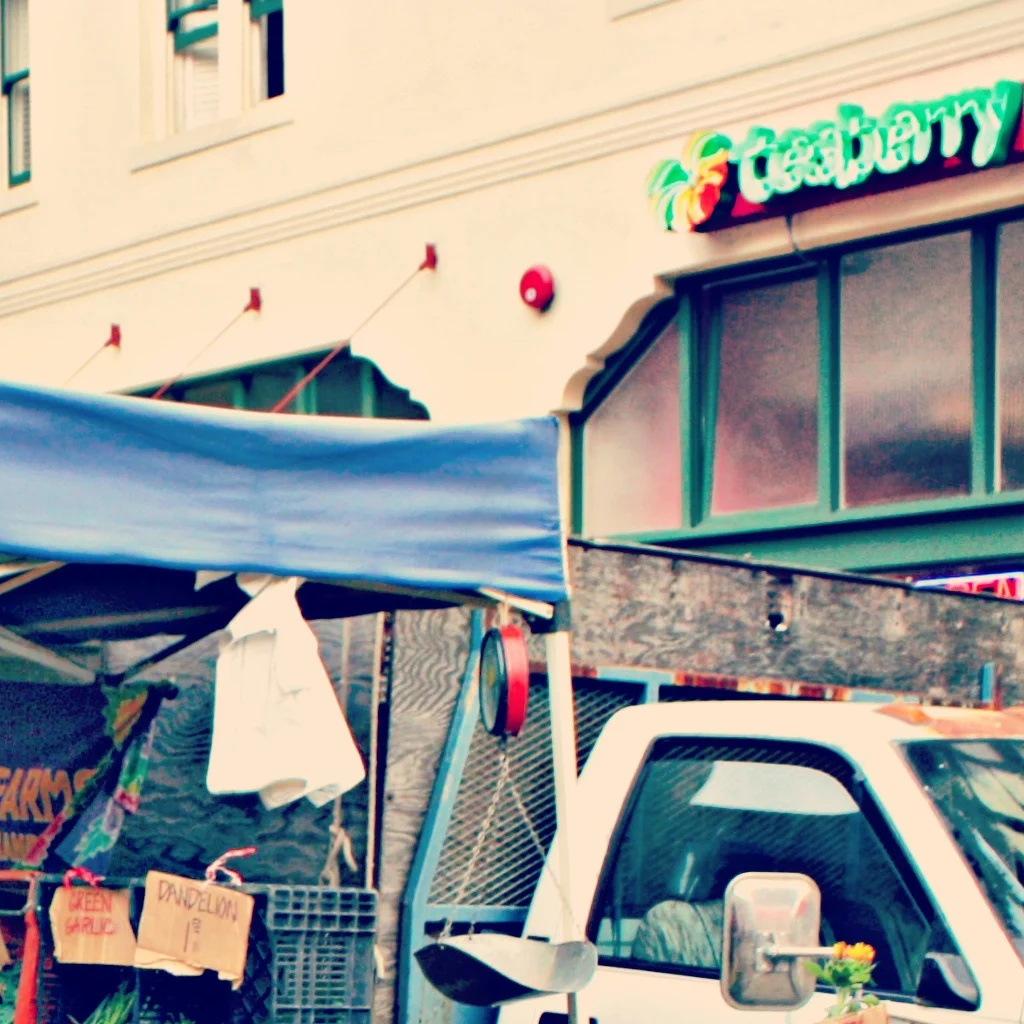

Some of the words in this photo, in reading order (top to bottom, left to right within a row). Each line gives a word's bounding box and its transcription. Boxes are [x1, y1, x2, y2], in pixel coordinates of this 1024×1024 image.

[68, 890, 113, 914] GREEN
[158, 878, 239, 922] DANDELION
[64, 916, 116, 935] GARLIC
